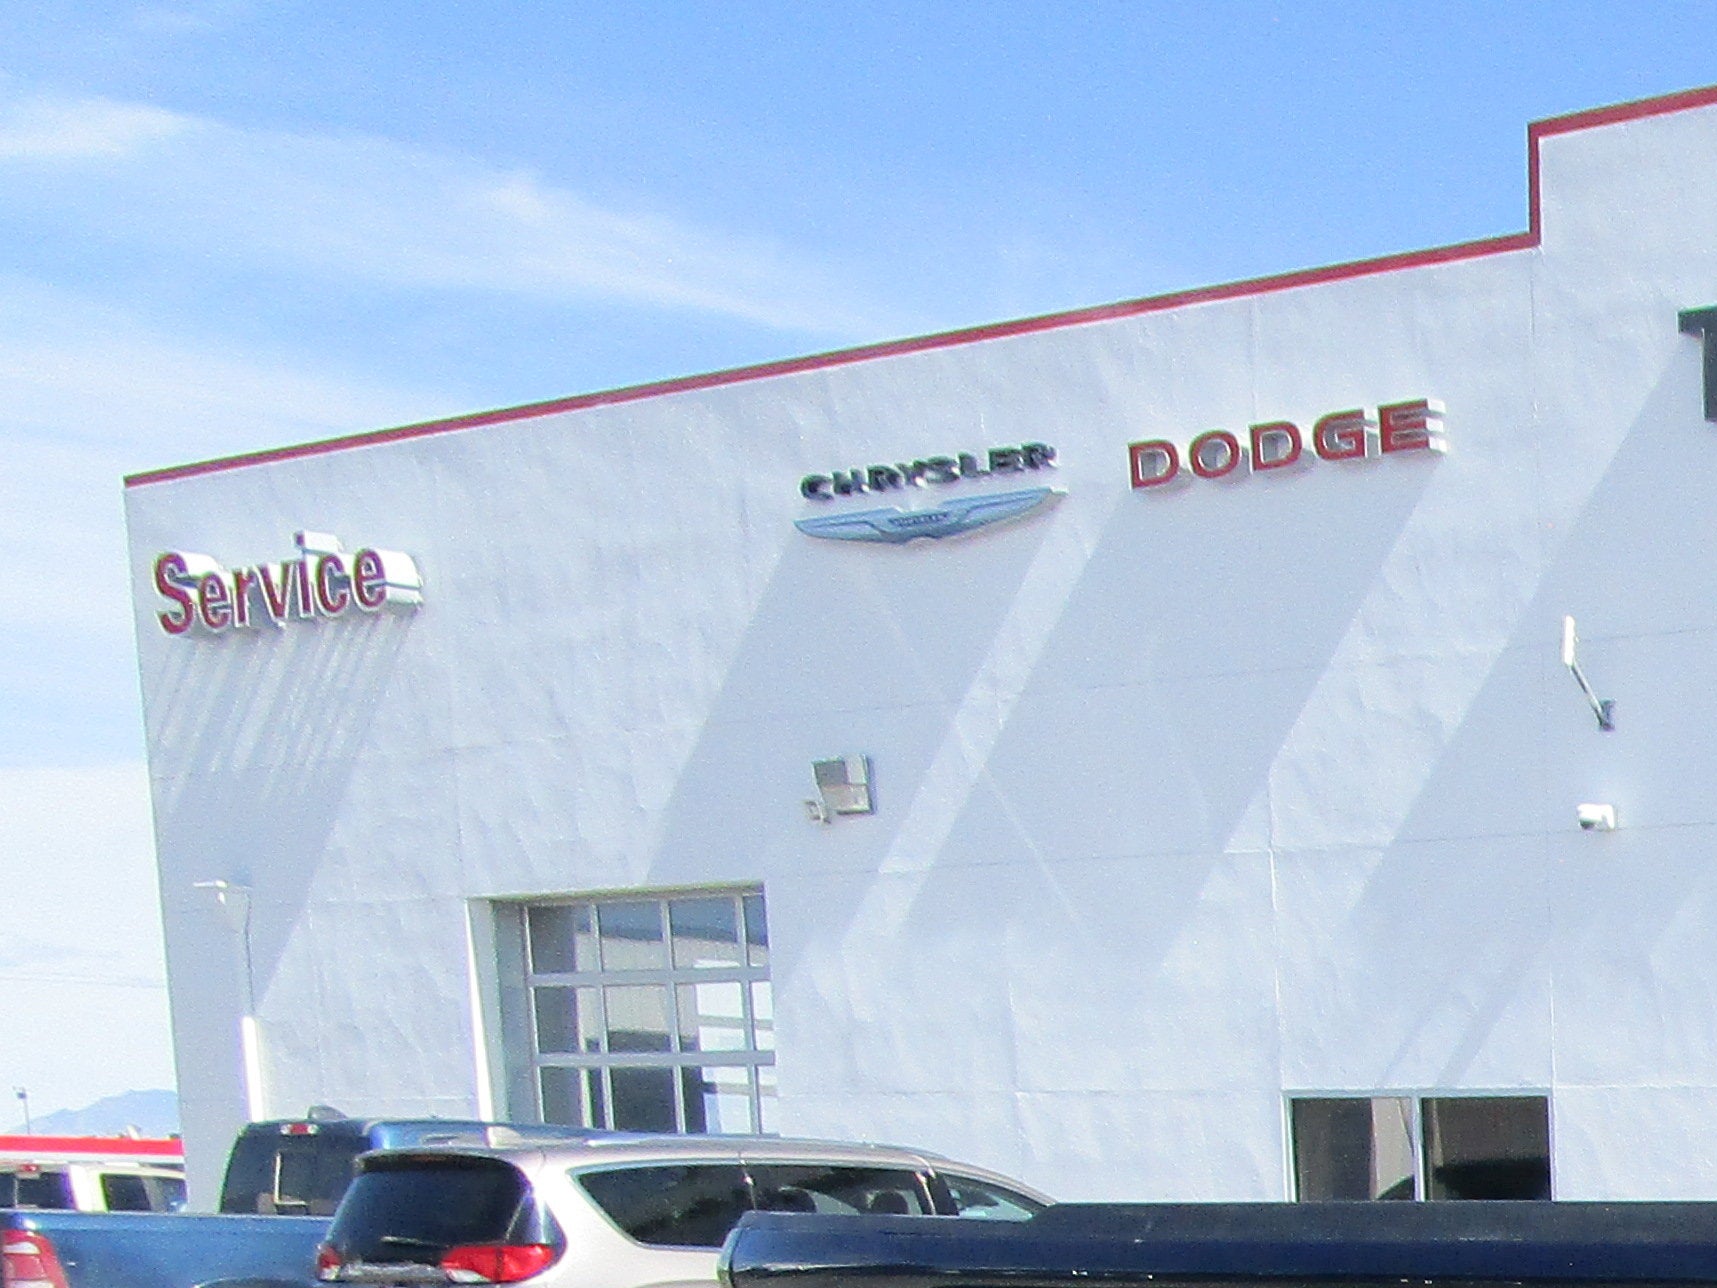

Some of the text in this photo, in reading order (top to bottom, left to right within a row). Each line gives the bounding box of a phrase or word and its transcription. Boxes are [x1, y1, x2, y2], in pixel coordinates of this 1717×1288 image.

[800, 441, 1060, 501] CHRYSLER
[1128, 398, 1444, 492] DODGE
[154, 530, 405, 636] Service
